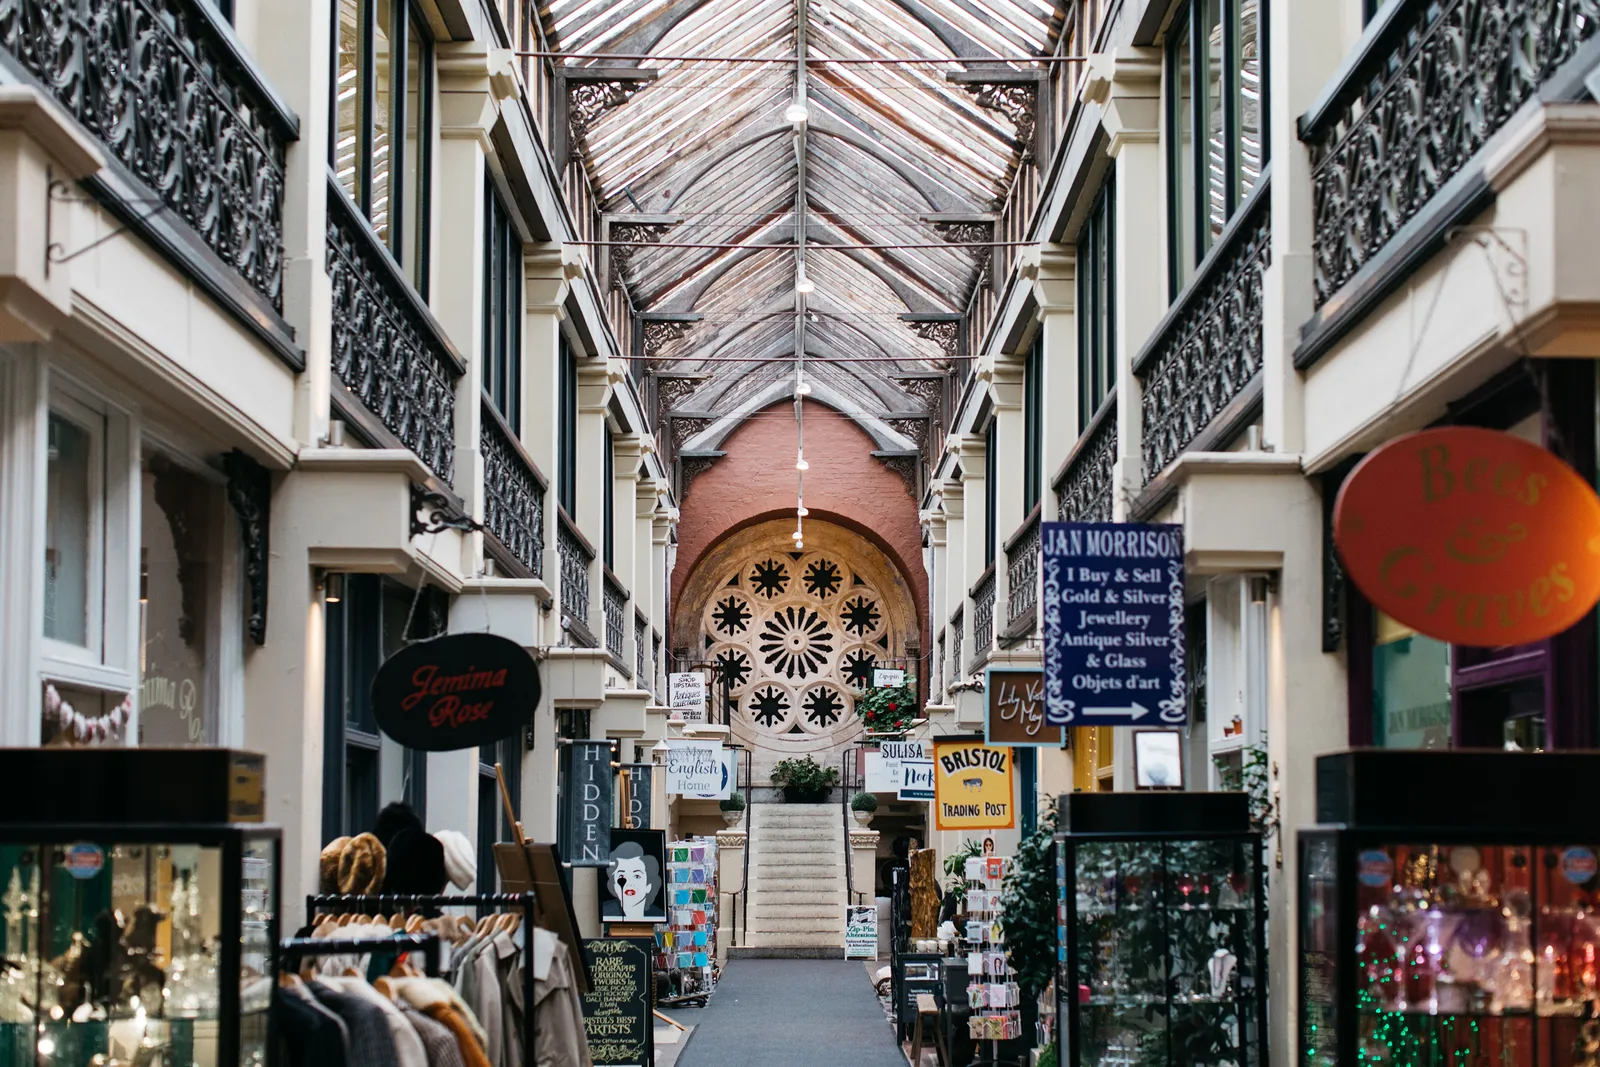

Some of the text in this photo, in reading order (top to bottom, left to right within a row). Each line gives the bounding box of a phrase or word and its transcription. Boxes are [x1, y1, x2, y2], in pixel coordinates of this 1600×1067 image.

[1418, 444, 1548, 506] Bees
[1044, 529, 1181, 558] JAN MORRISON
[1446, 517, 1528, 565] &
[1067, 567, 1162, 586] I Buy & Sell
[1061, 588, 1168, 604] Gold & Silver
[1077, 610, 1151, 629] Jewellery
[1061, 631, 1169, 651] Antique Silver
[1086, 653, 1147, 668] & Glass
[402, 665, 508, 711] Jemima
[1072, 674, 1161, 694] Objets d'art
[998, 681, 1020, 719] Lily
[429, 695, 494, 728] Rose
[1020, 700, 1042, 735] May
[882, 743, 923, 759] SULISA
[941, 748, 1006, 774] BRISTOL
[668, 758, 719, 779] English
[677, 780, 711, 791] Home
[582, 745, 600, 861] HIDDEN
[595, 956, 623, 966] RARE
[594, 1008, 622, 1016] alongside
[616, 1016, 637, 1024] BEST
